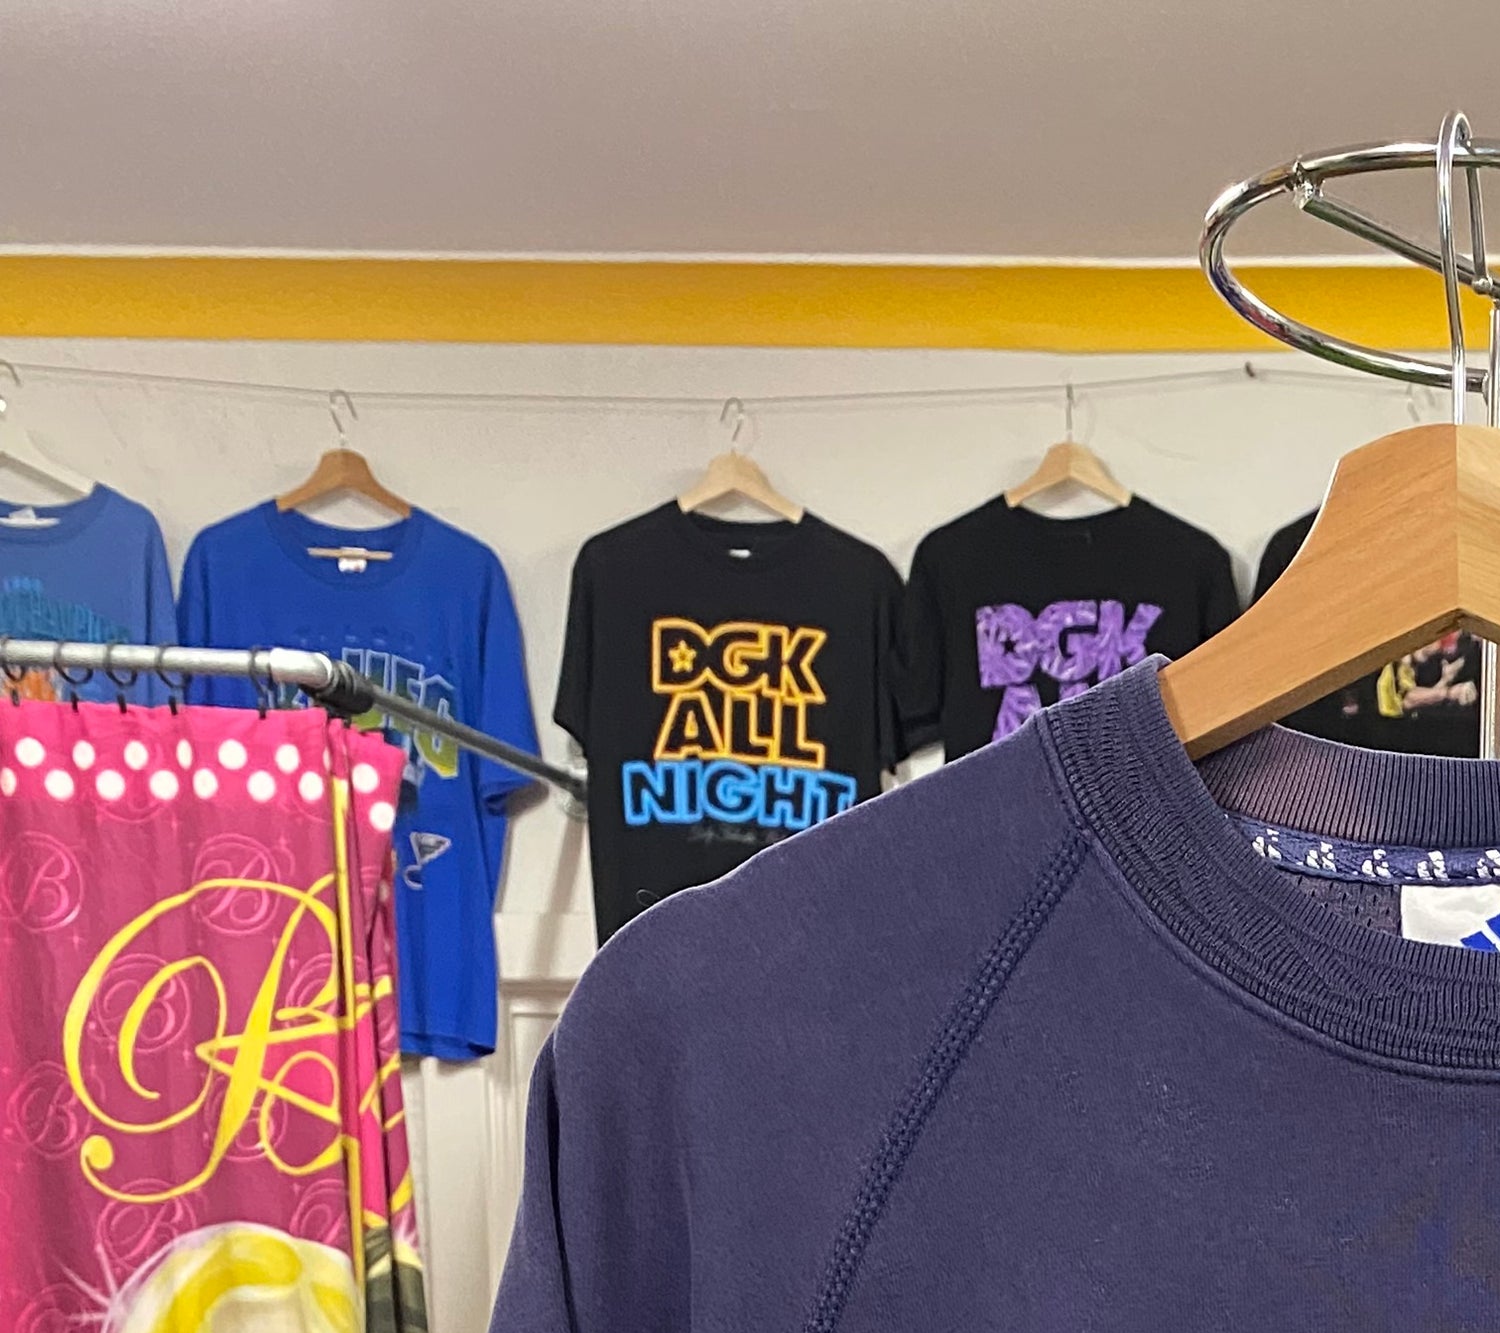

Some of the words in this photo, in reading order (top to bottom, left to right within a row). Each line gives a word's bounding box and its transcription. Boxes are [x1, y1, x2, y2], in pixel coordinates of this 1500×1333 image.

[652, 616, 827, 705] DGK
[976, 600, 1164, 688] DGK
[653, 690, 826, 770] ALL
[622, 760, 857, 831] NIGHT
